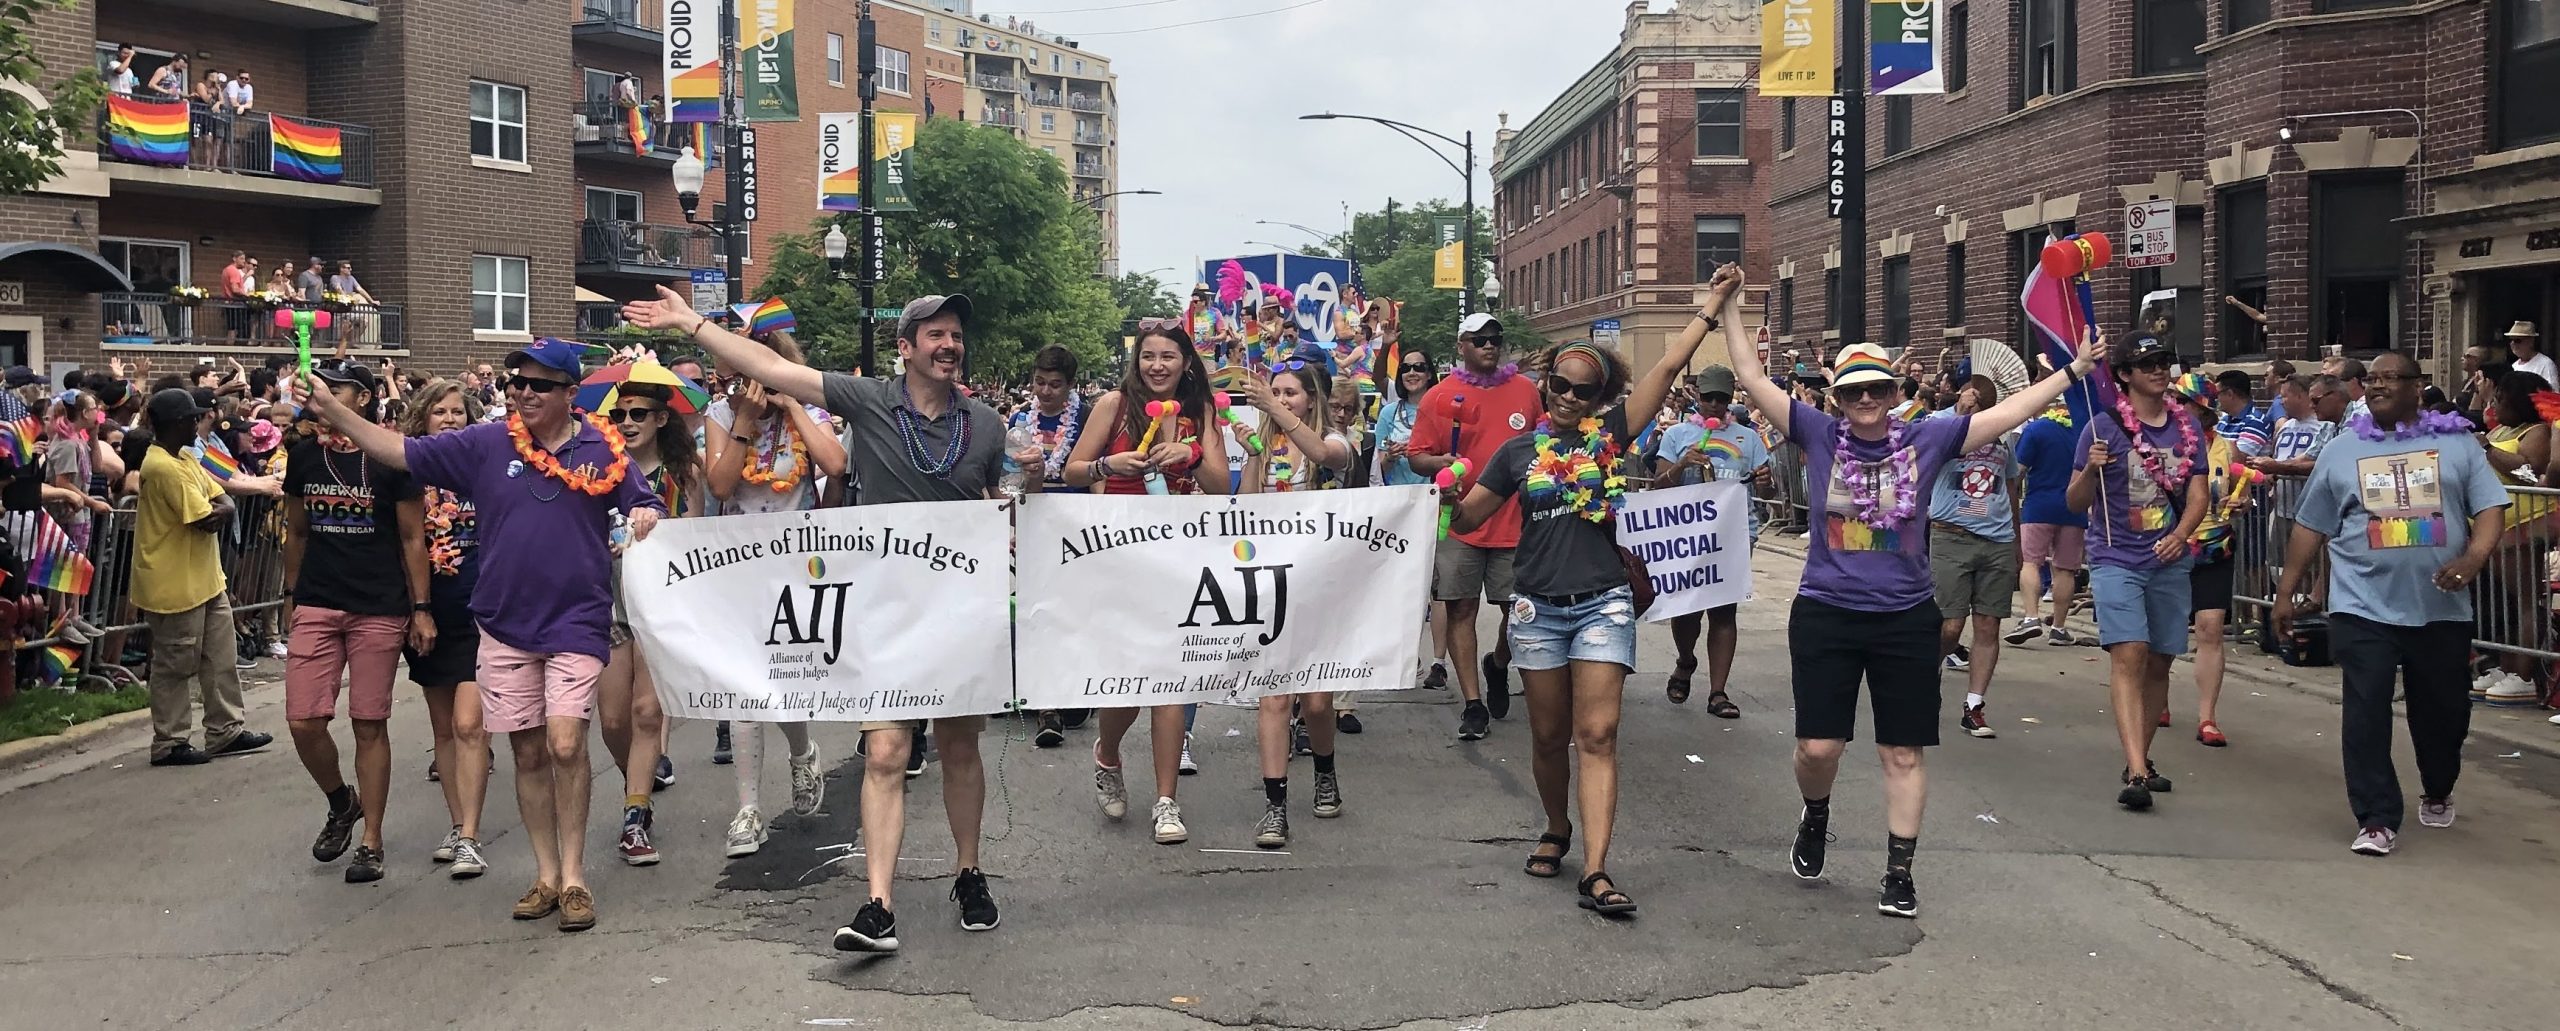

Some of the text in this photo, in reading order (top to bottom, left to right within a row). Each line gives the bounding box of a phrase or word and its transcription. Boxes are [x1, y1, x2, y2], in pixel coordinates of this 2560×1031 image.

[671, 0, 692, 69] PROUD
[1778, 71, 1816, 81] LIVE IT UP
[823, 123, 839, 173] PROUD
[887, 124, 903, 184] UPTOWN
[1830, 99, 1846, 215] BR4267
[742, 131, 755, 220] BR4260
[874, 216, 884, 280] BR4262
[2146, 231, 2164, 242] BUS
[2147, 242, 2169, 253] STOP
[2129, 254, 2172, 267] TOW ZONE
[883, 310, 902, 318] CULL
[1458, 291, 1466, 322] BR43
[346, 526, 375, 534] BEGAN
[1624, 499, 1718, 533] ILLINOIS
[1060, 509, 1410, 565] Alliance of Illinois Judges
[665, 526, 979, 587] Alliance of Illinois Judges
[1650, 564, 1724, 596] OUNCIL
[1178, 563, 1293, 646] AIJ
[765, 582, 853, 665] AIJ
[1181, 648, 1260, 663] Illinois Judges
[1182, 632, 1246, 648] Alliance of
[768, 651, 815, 666] Alliance of
[768, 667, 829, 682] Illinois Judges
[1083, 661, 1374, 696] LGBT and Allied Judges of Illinois
[688, 688, 944, 715] LGBT and Allied Judges of Illinois
